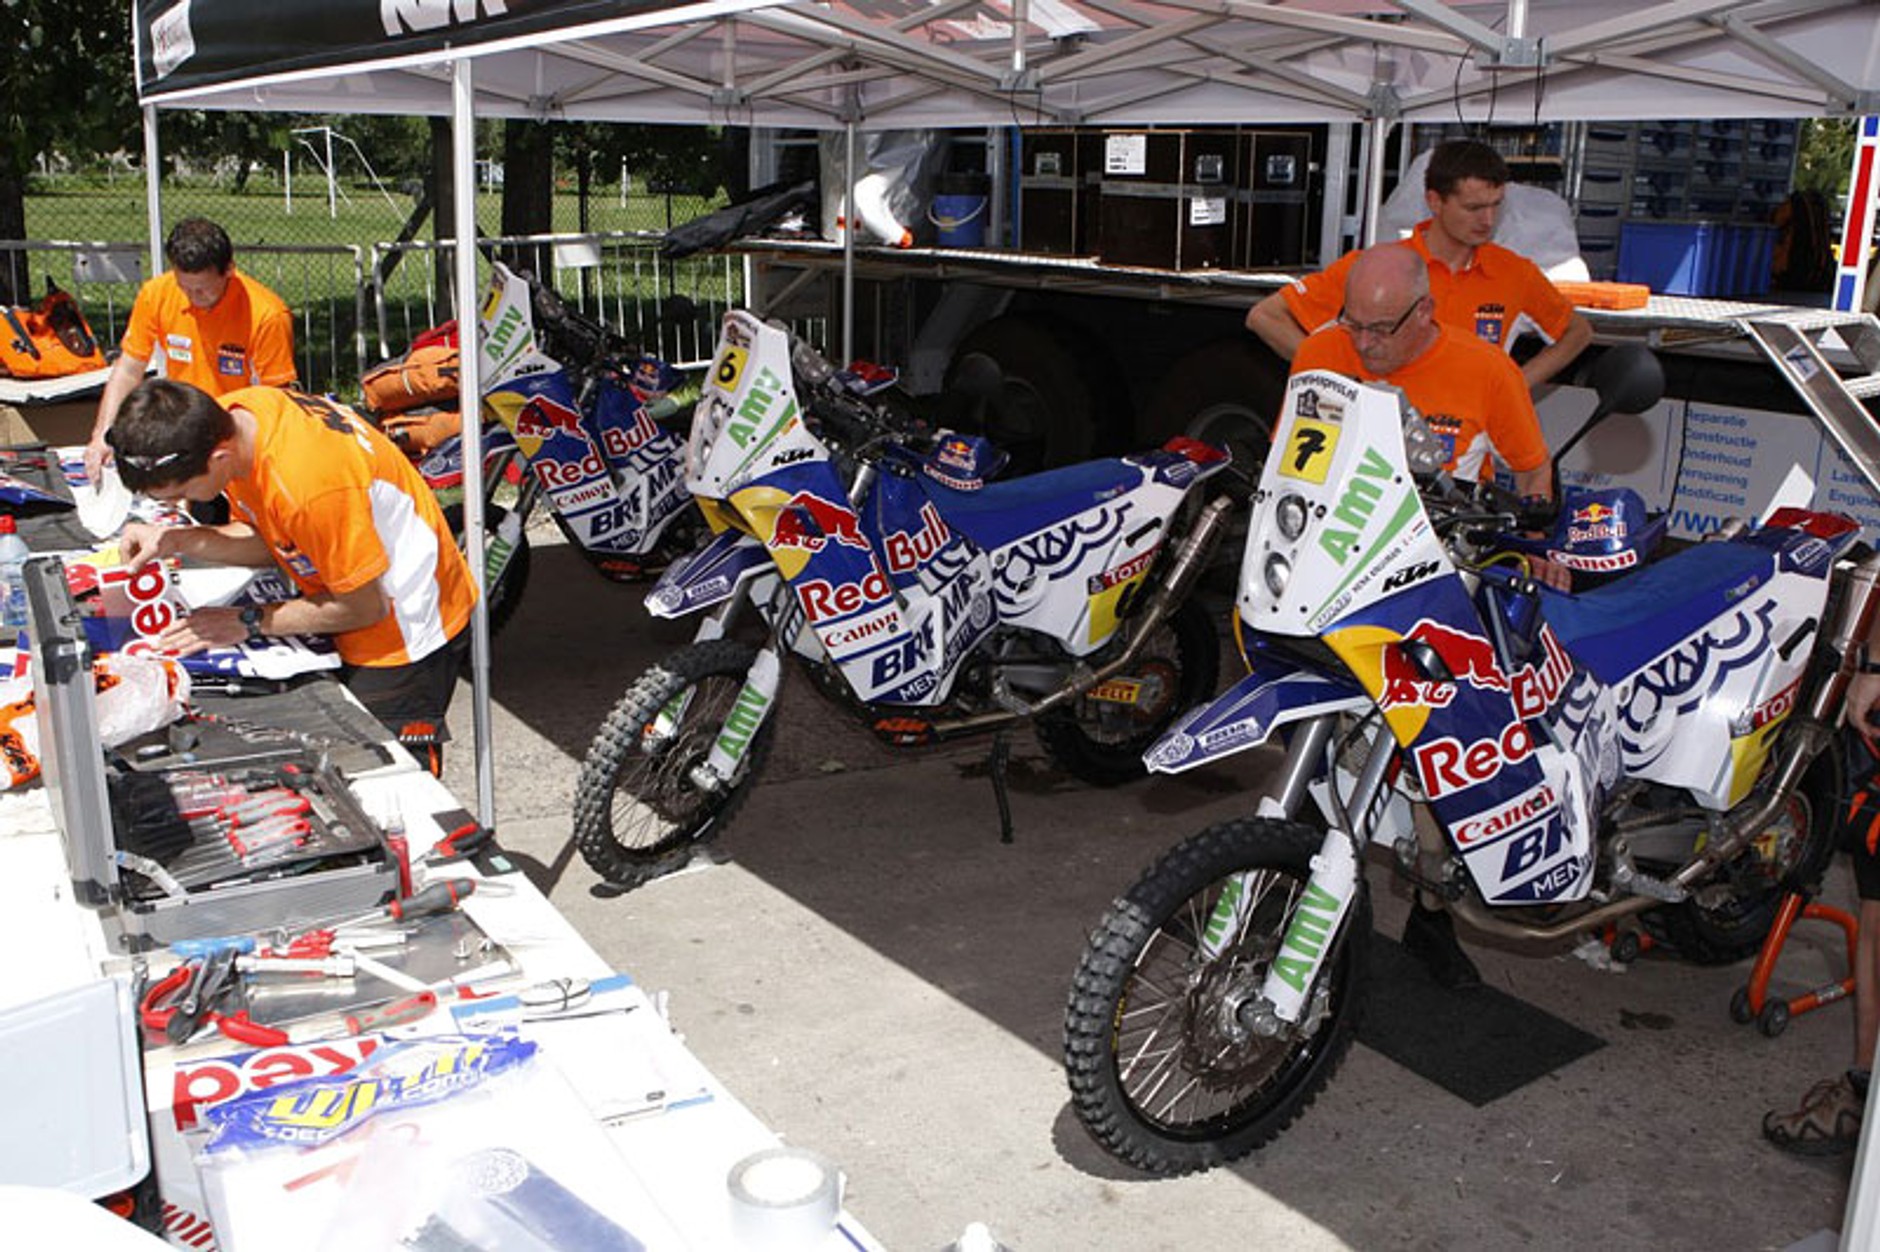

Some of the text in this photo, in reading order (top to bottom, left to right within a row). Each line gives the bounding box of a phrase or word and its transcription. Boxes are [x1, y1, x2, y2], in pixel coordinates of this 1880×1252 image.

[718, 352, 737, 383] 6
[602, 408, 658, 457] Bull
[1294, 427, 1327, 471] 7
[535, 439, 606, 491] Red
[556, 482, 611, 508] Canon
[885, 504, 949, 572] Bull
[1382, 560, 1440, 593] KTM
[1548, 550, 1636, 571] Canon
[800, 555, 892, 622] Red
[824, 611, 899, 648] Canon
[1511, 624, 1572, 718] Bull
